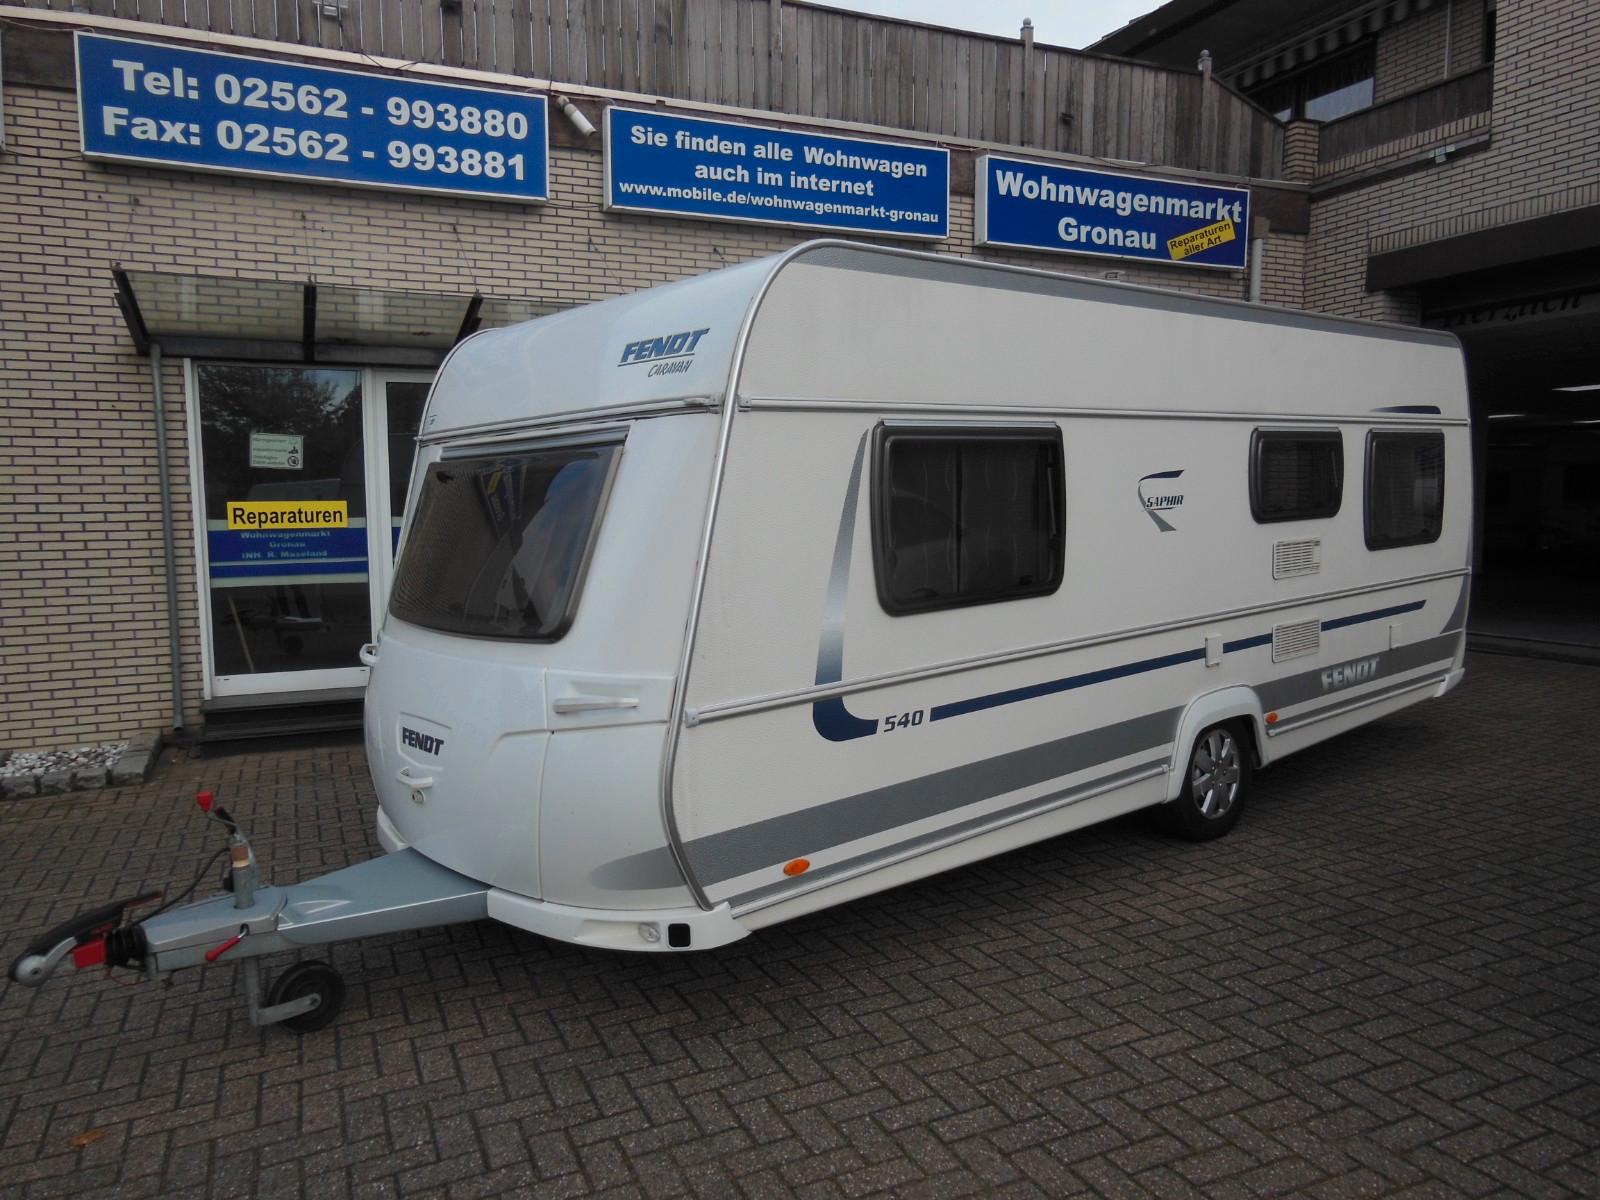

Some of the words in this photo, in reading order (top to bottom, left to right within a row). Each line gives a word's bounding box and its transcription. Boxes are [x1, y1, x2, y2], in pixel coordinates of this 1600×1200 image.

[112, 59, 199, 100] Tel:
[214, 73, 349, 119] 02562
[361, 106, 374, 116] -
[386, 96, 528, 140] 993880
[103, 106, 200, 145] Fax:
[216, 119, 349, 162] 02562
[362, 151, 375, 159] -
[387, 140, 525, 181] 993881
[631, 126, 668, 147] Sie
[675, 131, 746, 156] finden
[753, 142, 793, 161] alle
[804, 146, 928, 179] Wohnwagen
[695, 163, 749, 183] auch
[757, 167, 783, 187] im
[790, 171, 874, 197] internet
[996, 170, 1242, 223] Wohnwagenmarkt
[619, 181, 939, 223] www.mobile.de/wohnwagenmarkt-gronau
[1058, 217, 1157, 250] Gronau
[1170, 223, 1231, 250] Reparaturen
[1184, 243, 1204, 256] aller
[1207, 235, 1222, 247] Art
[621, 328, 711, 363] FENDT
[648, 359, 693, 378] CARAVAN
[233, 508, 343, 528] Reparaturen
[1146, 495, 1184, 508] SAPHIR
[1321, 656, 1380, 691] FENDT
[883, 710, 924, 732] 540
[402, 726, 445, 756] FENDT
